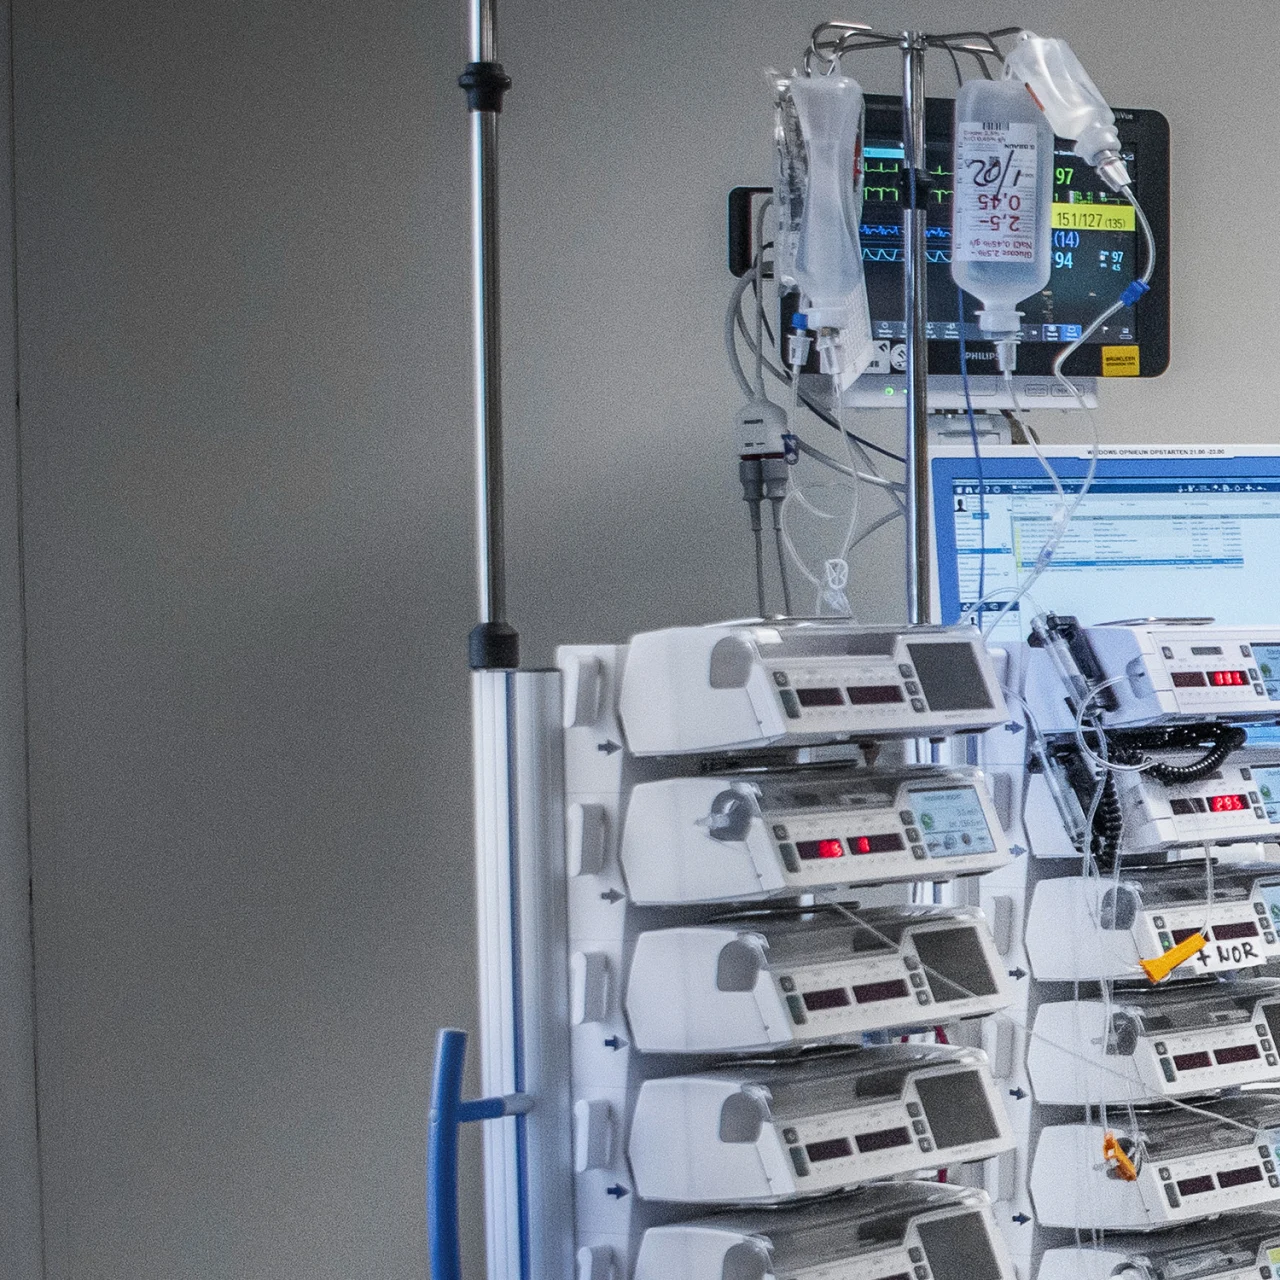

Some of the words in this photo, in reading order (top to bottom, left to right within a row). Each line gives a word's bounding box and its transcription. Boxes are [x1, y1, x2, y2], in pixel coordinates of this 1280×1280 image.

[1055, 168, 1074, 185] 97
[1057, 212, 1103, 227] 151/127
[1105, 218, 1126, 228] (135)
[1012, 240, 1033, 249] NaCl
[1054, 230, 1080, 248] (14)
[1001, 250, 1033, 259] Glucose
[1055, 252, 1074, 269] 94
[1111, 251, 1124, 263] 97
[965, 352, 1000, 361] PHILIPS
[1216, 941, 1259, 964] NOR
